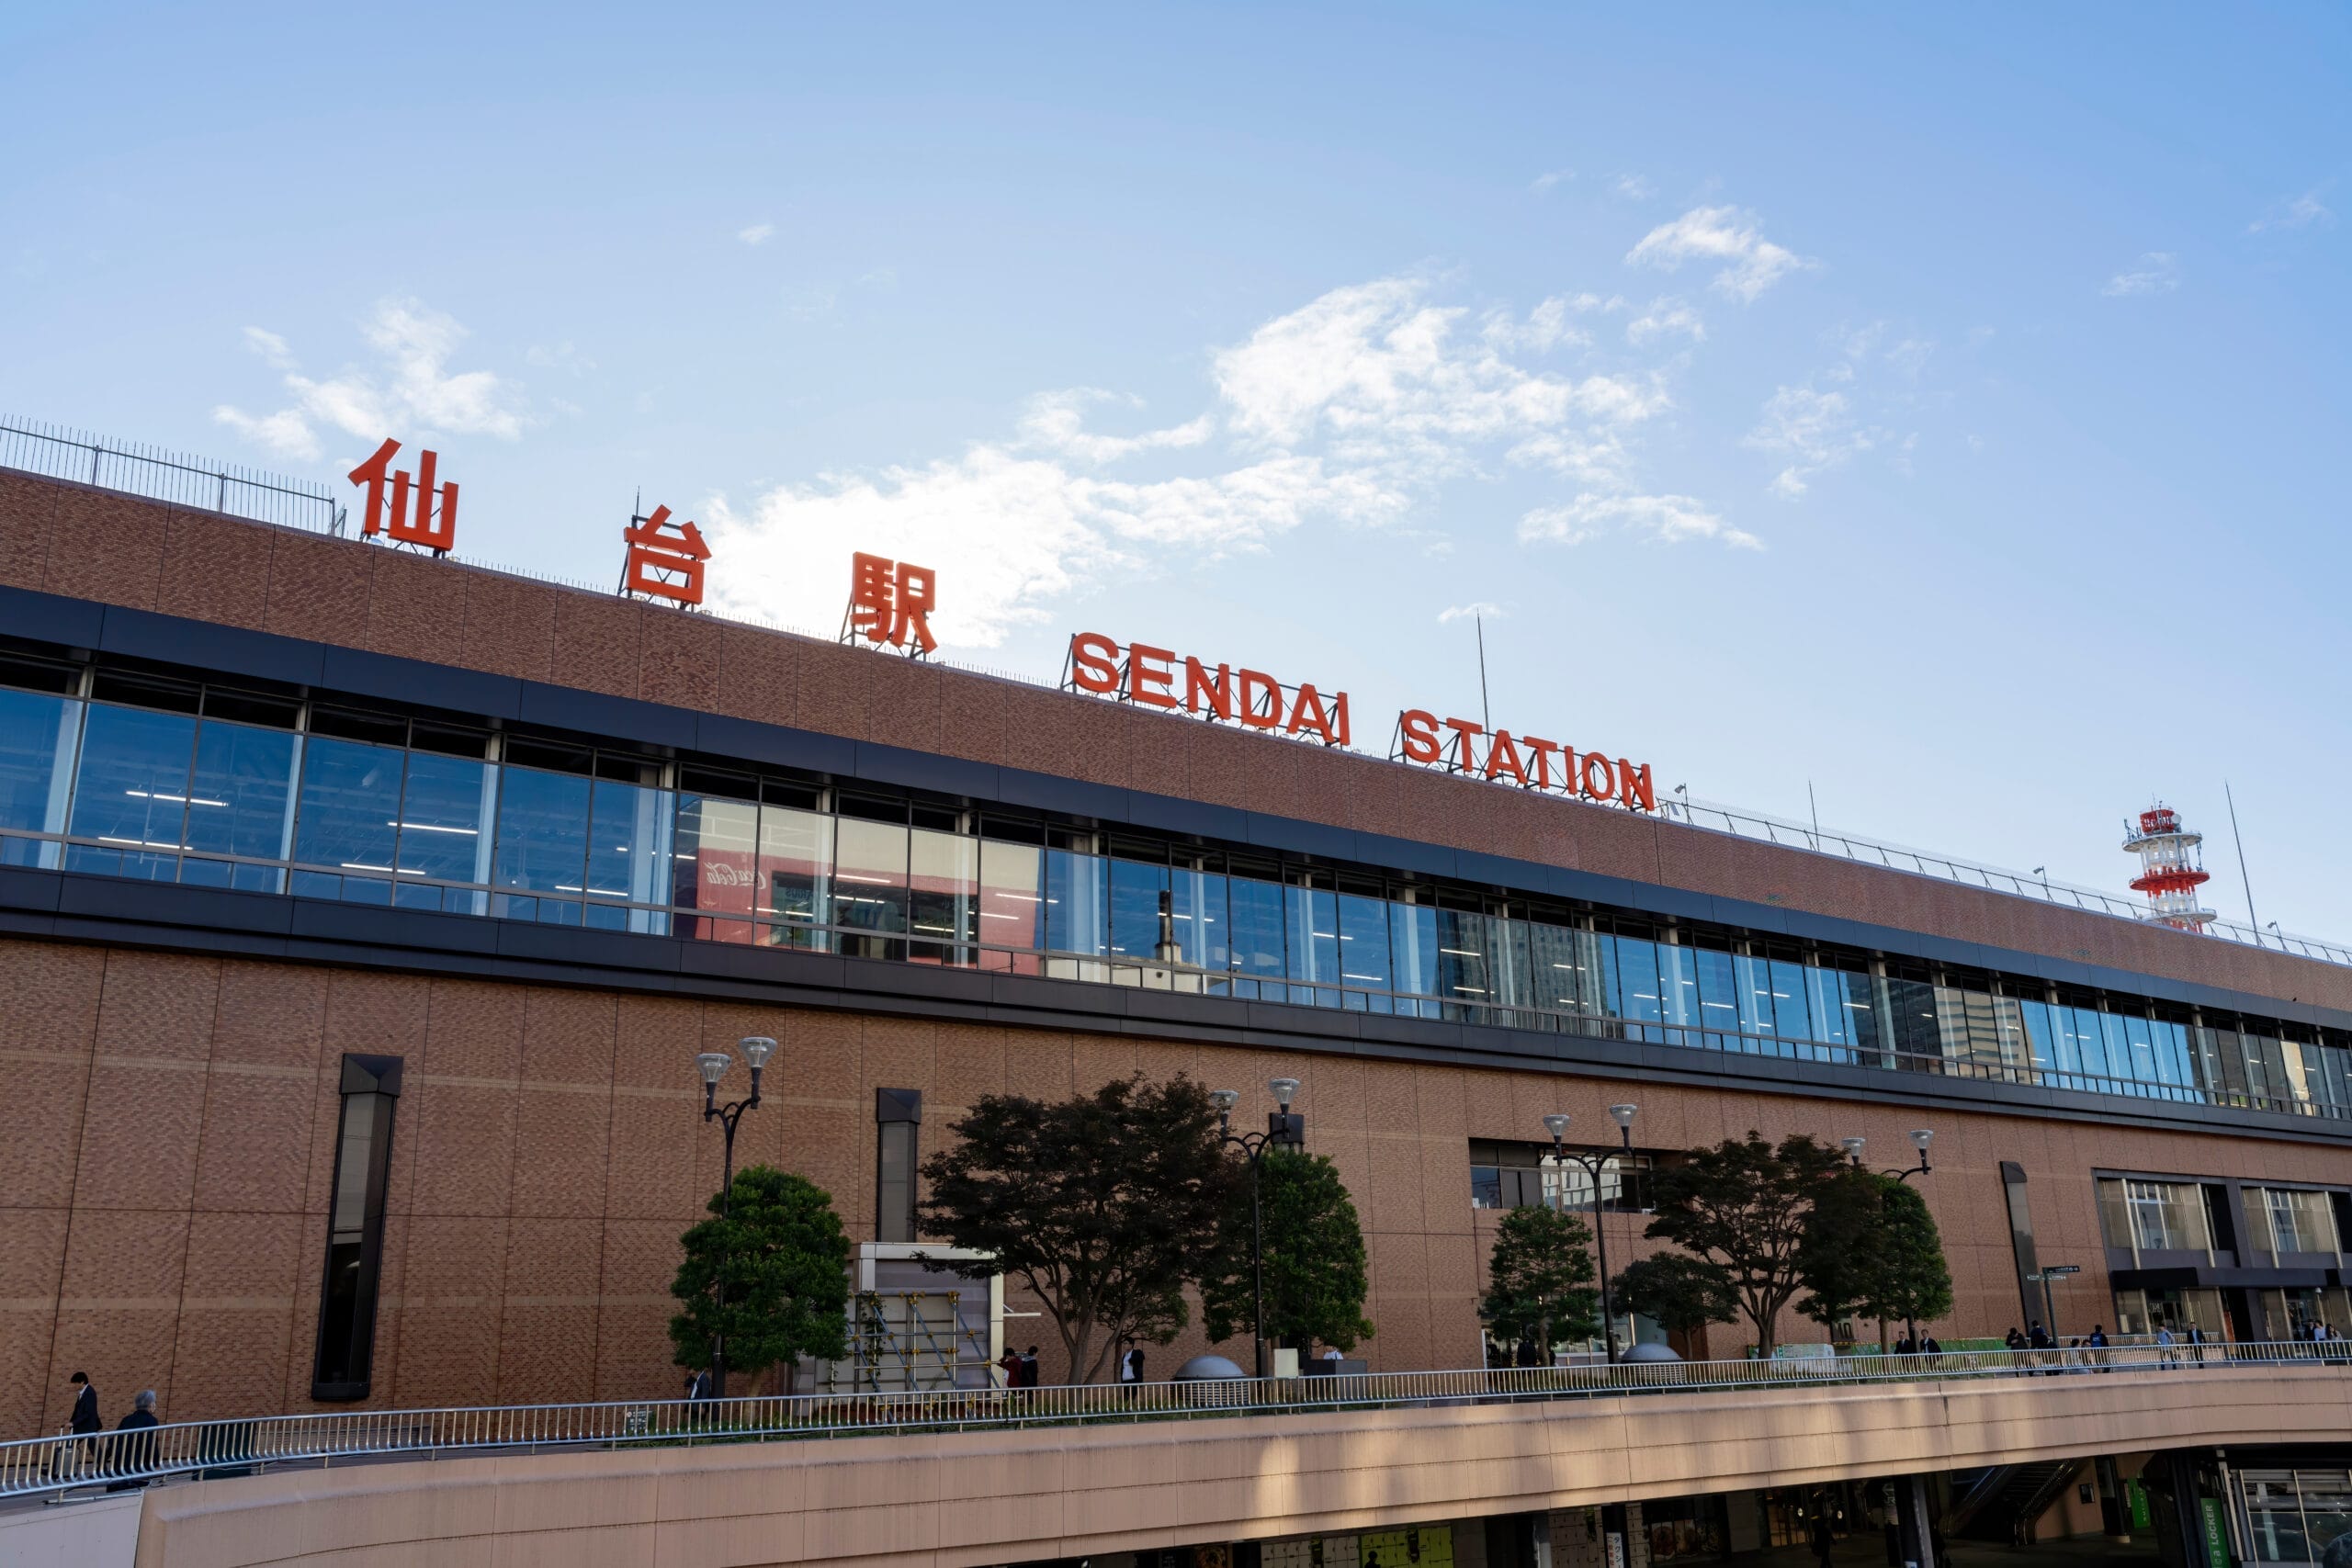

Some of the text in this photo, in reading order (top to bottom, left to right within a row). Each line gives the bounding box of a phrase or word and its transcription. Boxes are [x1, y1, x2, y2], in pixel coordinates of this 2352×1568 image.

[348, 437, 937, 653] 仙台駅
[1071, 632, 1656, 812] SENDAI STATION
[2205, 1505, 2219, 1545] LOCKER
